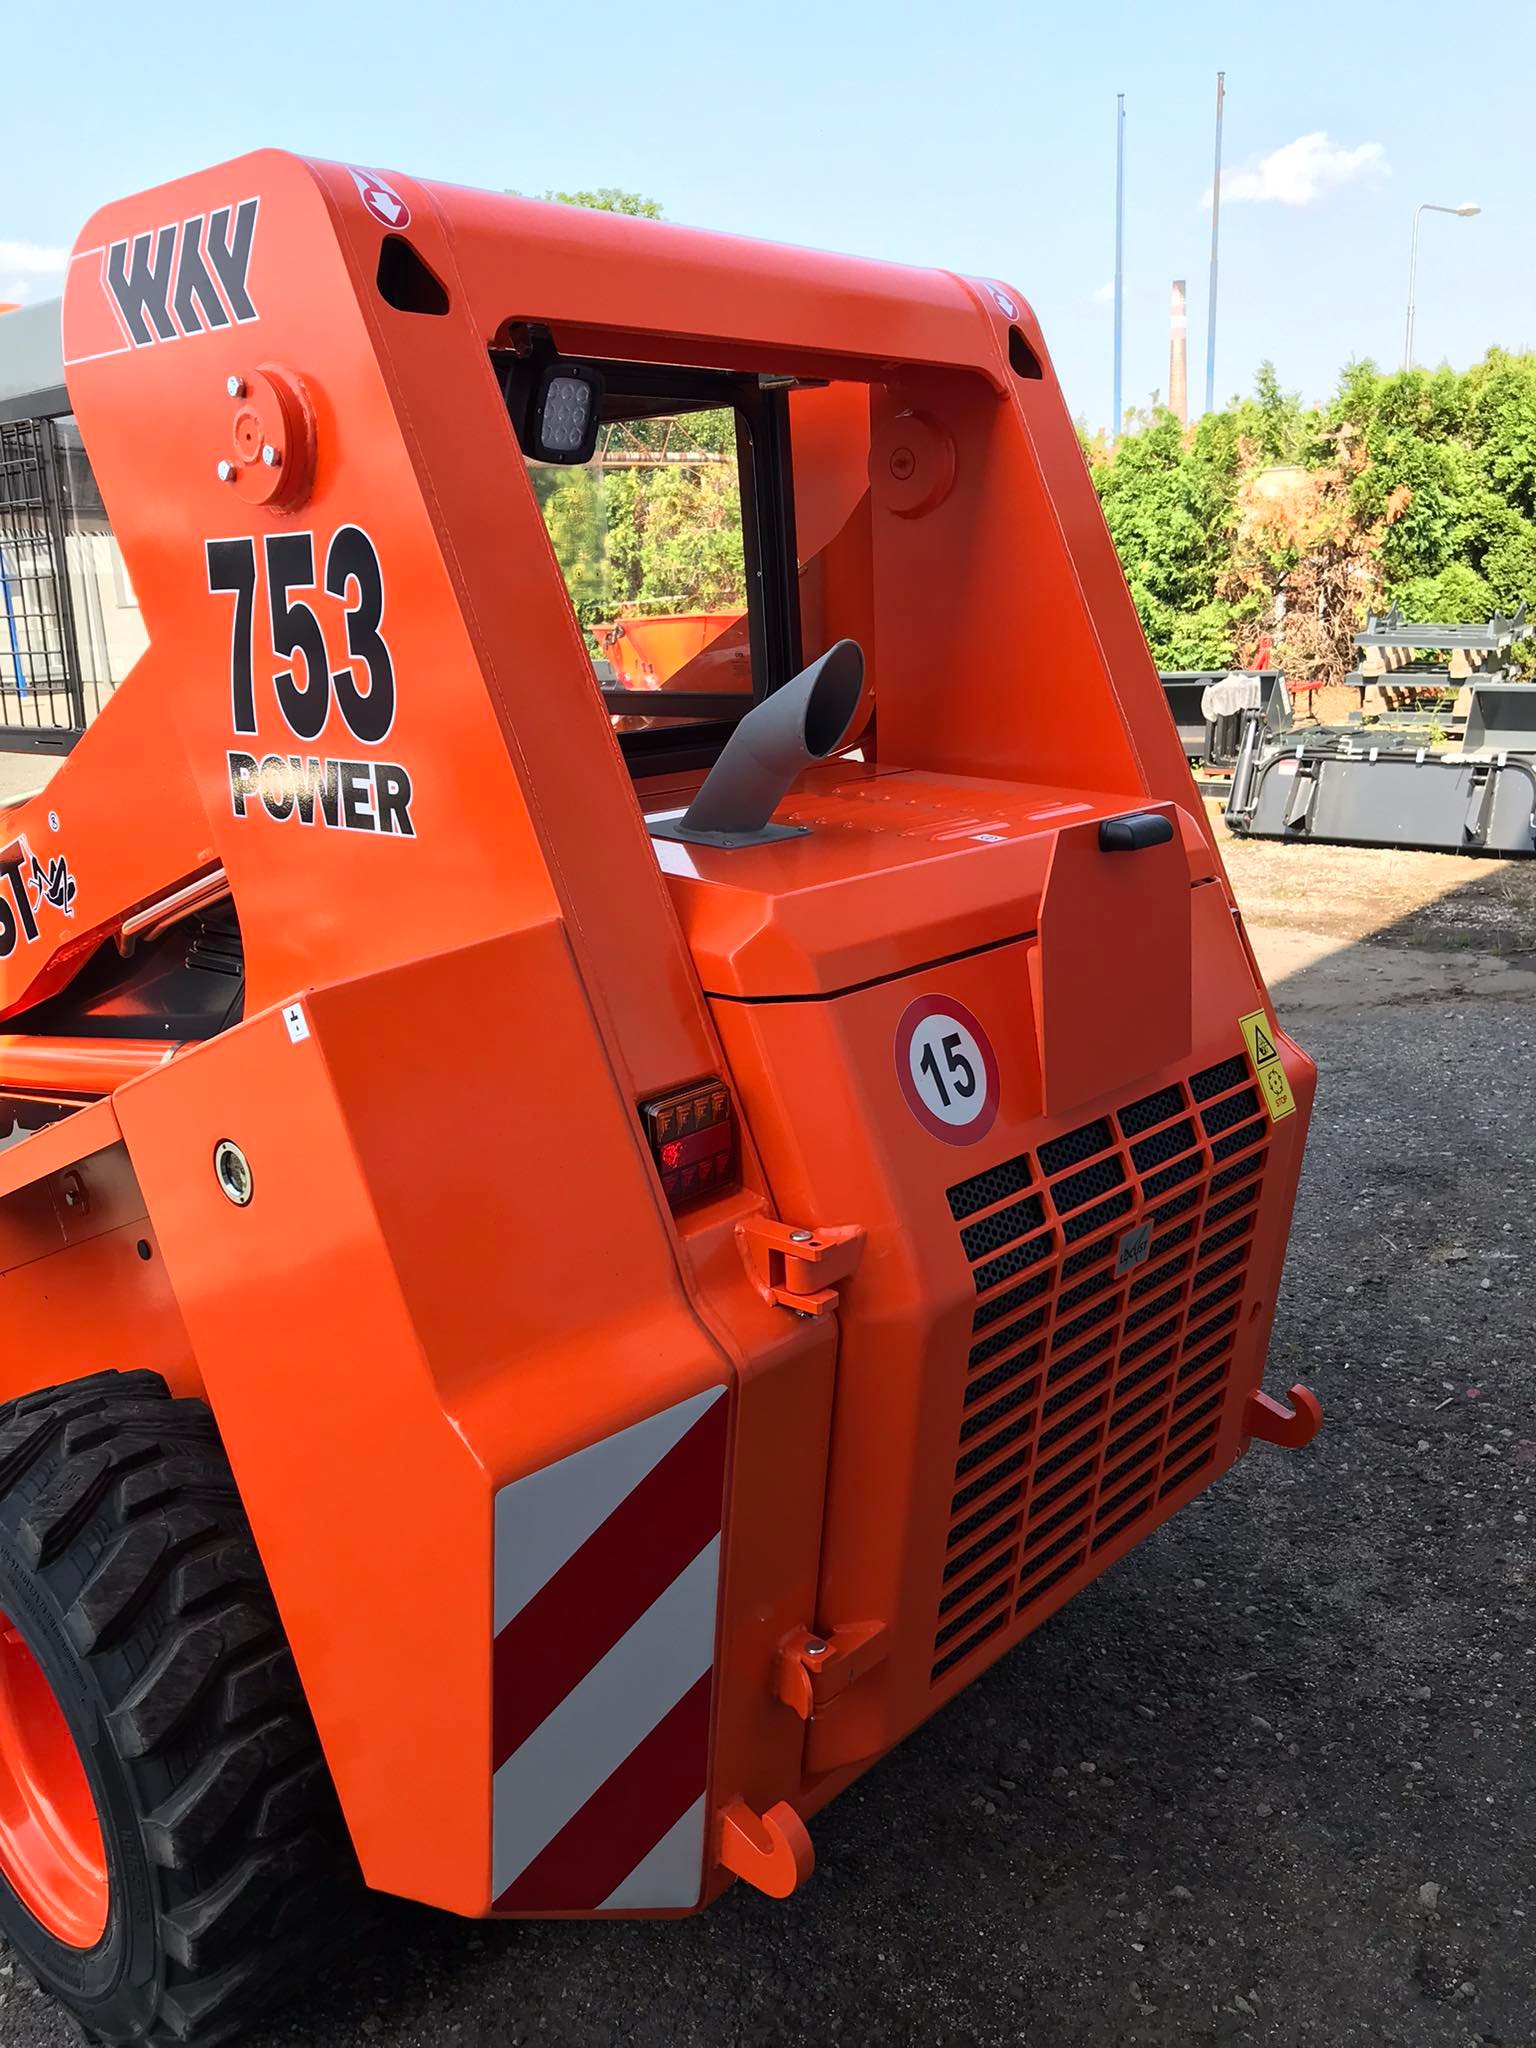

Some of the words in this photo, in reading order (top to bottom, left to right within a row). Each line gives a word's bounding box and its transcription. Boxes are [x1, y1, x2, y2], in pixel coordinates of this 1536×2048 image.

[106, 197, 260, 348] WAY
[205, 525, 396, 745] 753
[226, 750, 416, 838] POWER
[920, 1032, 976, 1107] 15
